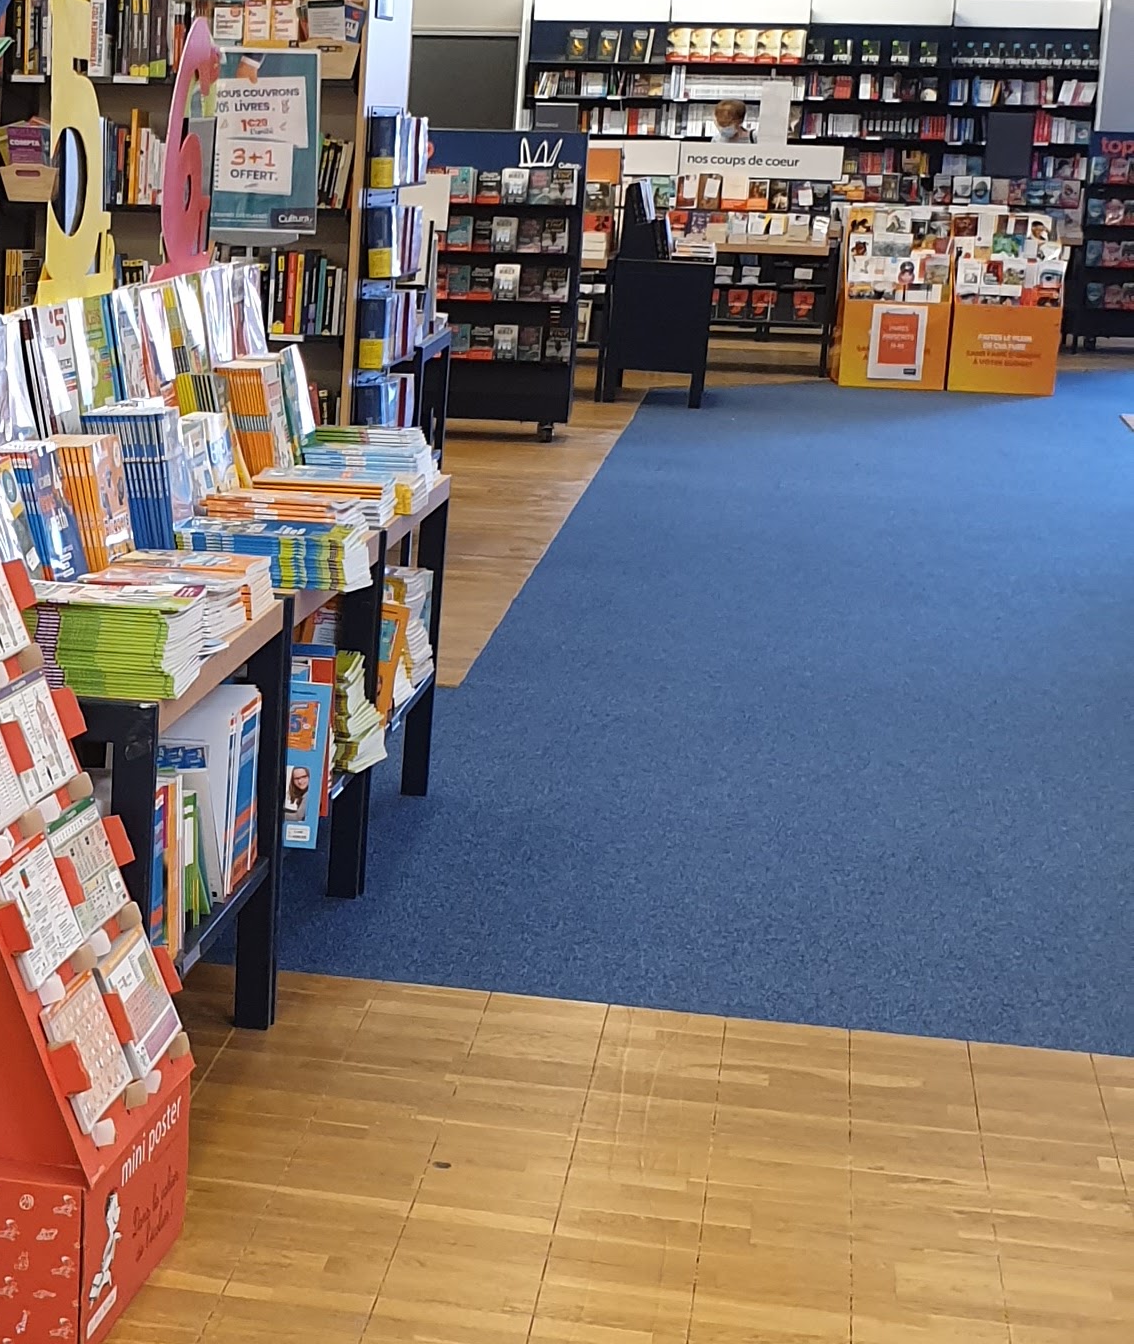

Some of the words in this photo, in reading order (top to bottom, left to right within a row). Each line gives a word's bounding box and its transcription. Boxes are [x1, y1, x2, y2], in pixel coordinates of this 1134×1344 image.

[243, 89, 299, 97] COUVRONS
[231, 148, 276, 167] 3+1
[687, 155, 708, 164] nos
[710, 156, 745, 166] coups
[748, 156, 762, 166] de
[766, 158, 799, 166] coeur
[121, 1133, 146, 1187] mini
[148, 1095, 182, 1162] poster
